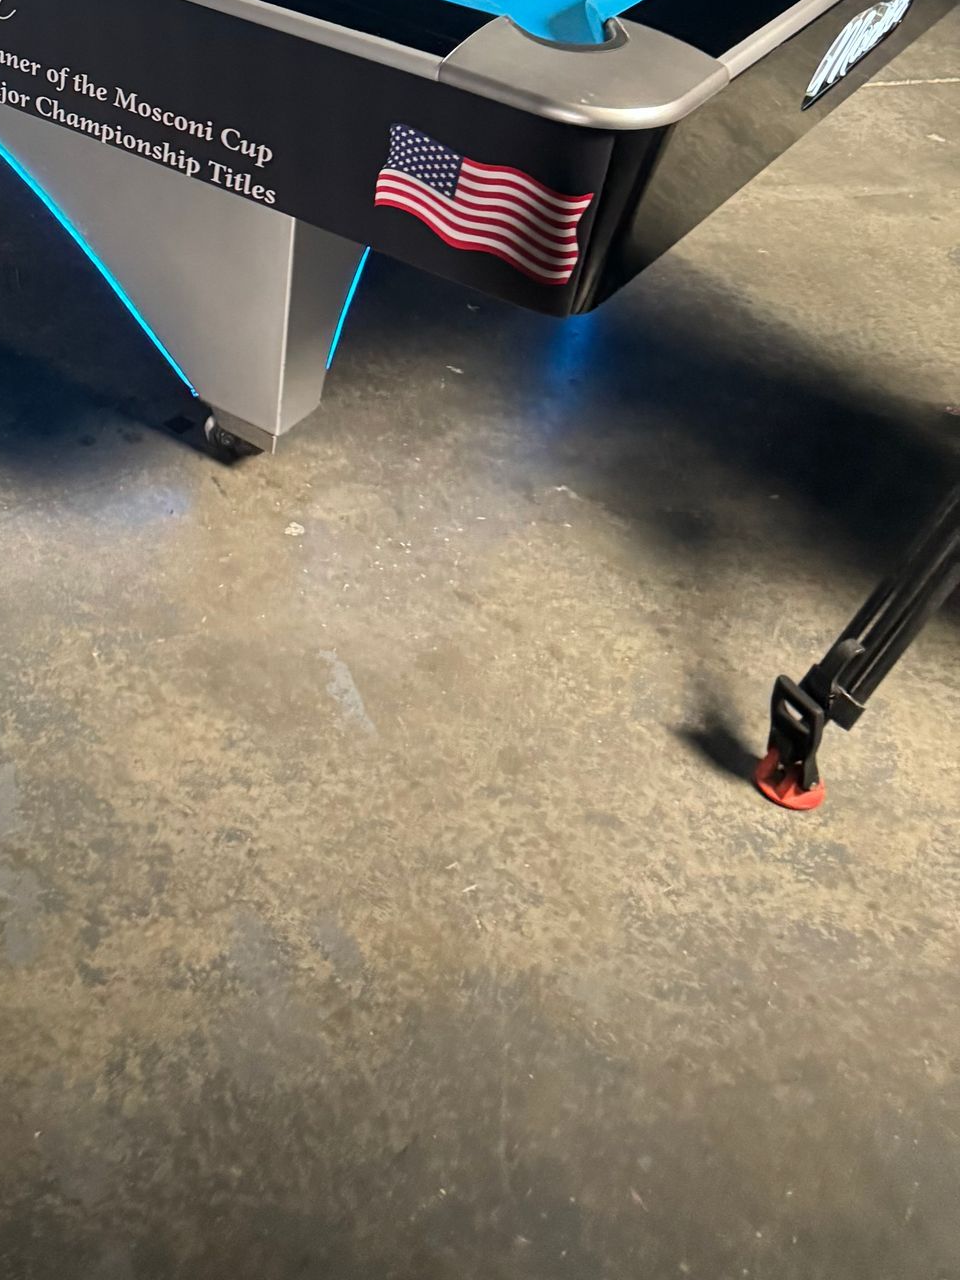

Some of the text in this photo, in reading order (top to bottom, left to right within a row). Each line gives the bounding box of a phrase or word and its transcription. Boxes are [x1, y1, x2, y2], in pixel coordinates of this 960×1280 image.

[35, 96, 201, 177] Championship
[207, 160, 277, 205] Titles
[46, 67, 70, 91] of
[72, 73, 108, 102] the
[112, 86, 214, 141] Mosconi
[220, 128, 273, 168] Cup
